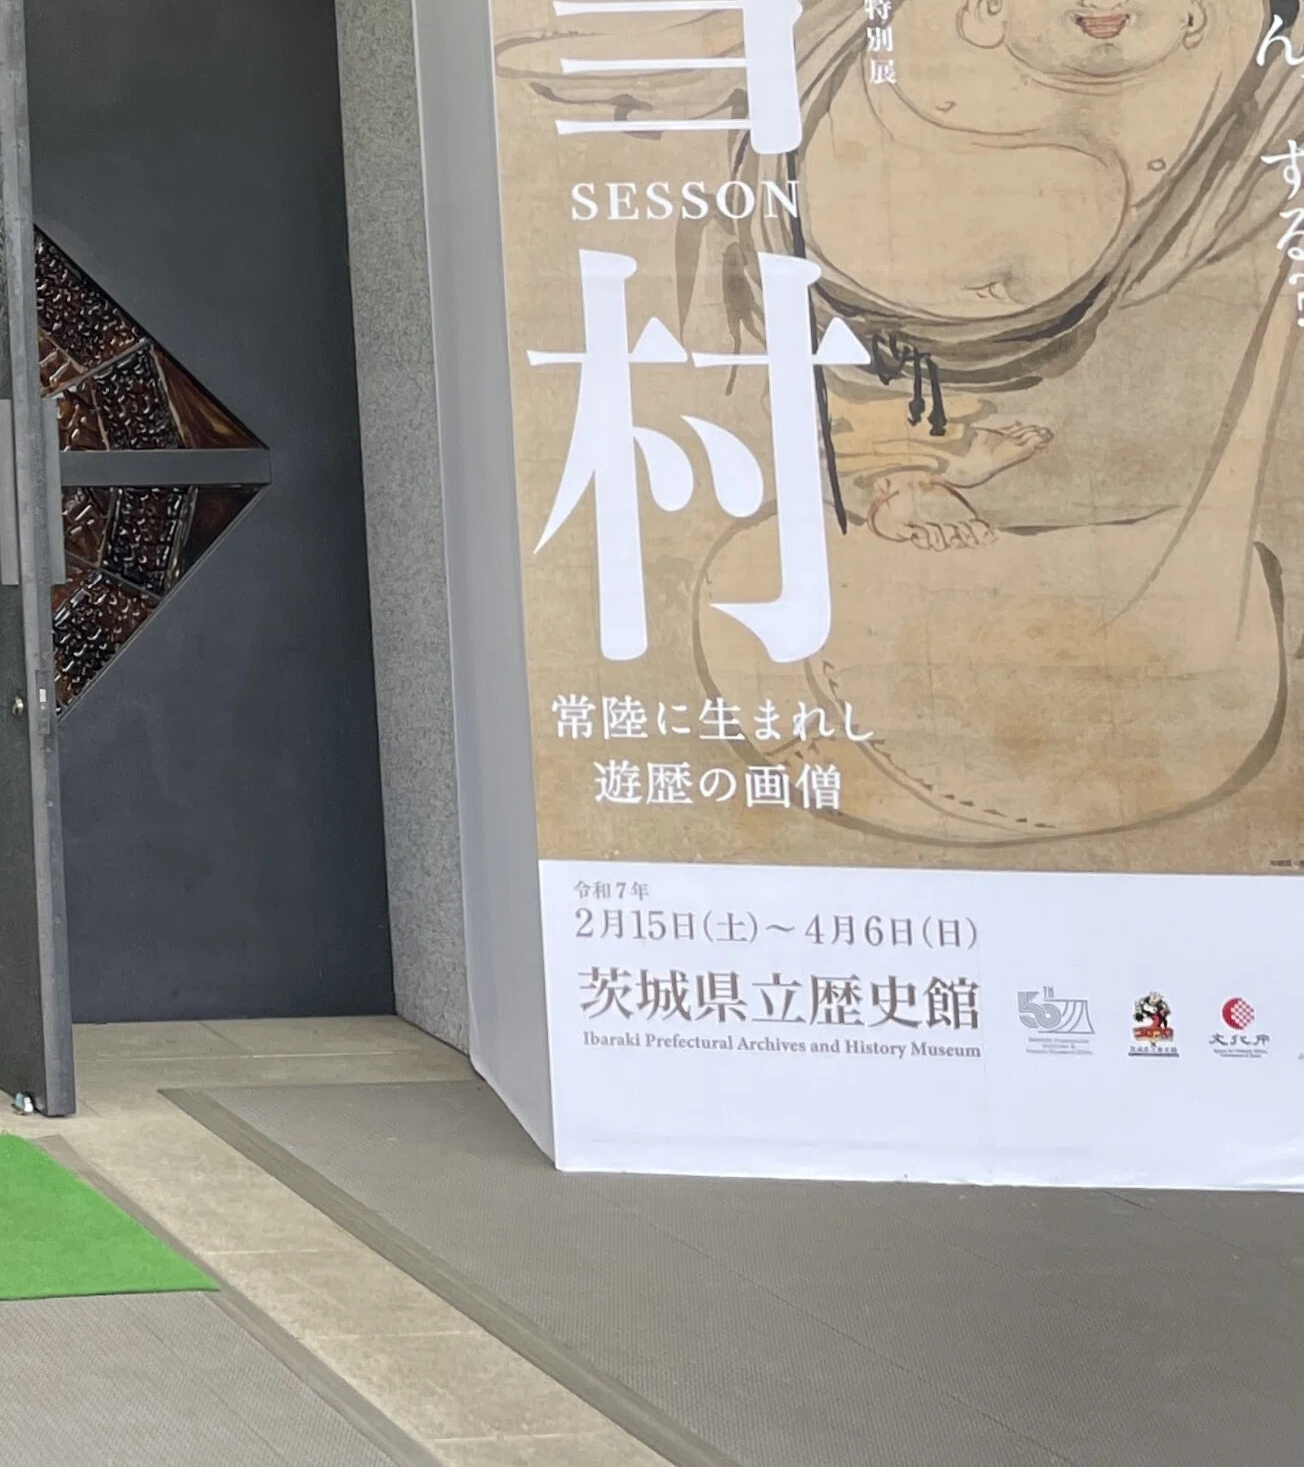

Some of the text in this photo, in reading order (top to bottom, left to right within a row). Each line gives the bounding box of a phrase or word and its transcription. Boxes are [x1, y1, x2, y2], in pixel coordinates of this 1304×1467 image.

[569, 180, 801, 222] SESSON
[550, 692, 876, 743] 常陸に生まれし
[593, 760, 842, 811] 遊歴の画僧
[572, 880, 651, 902] 令和7年
[576, 965, 982, 1032] 茨城県立歴史館
[583, 1031, 982, 1059] Ibaraki Prefectural Archives and History Museum
